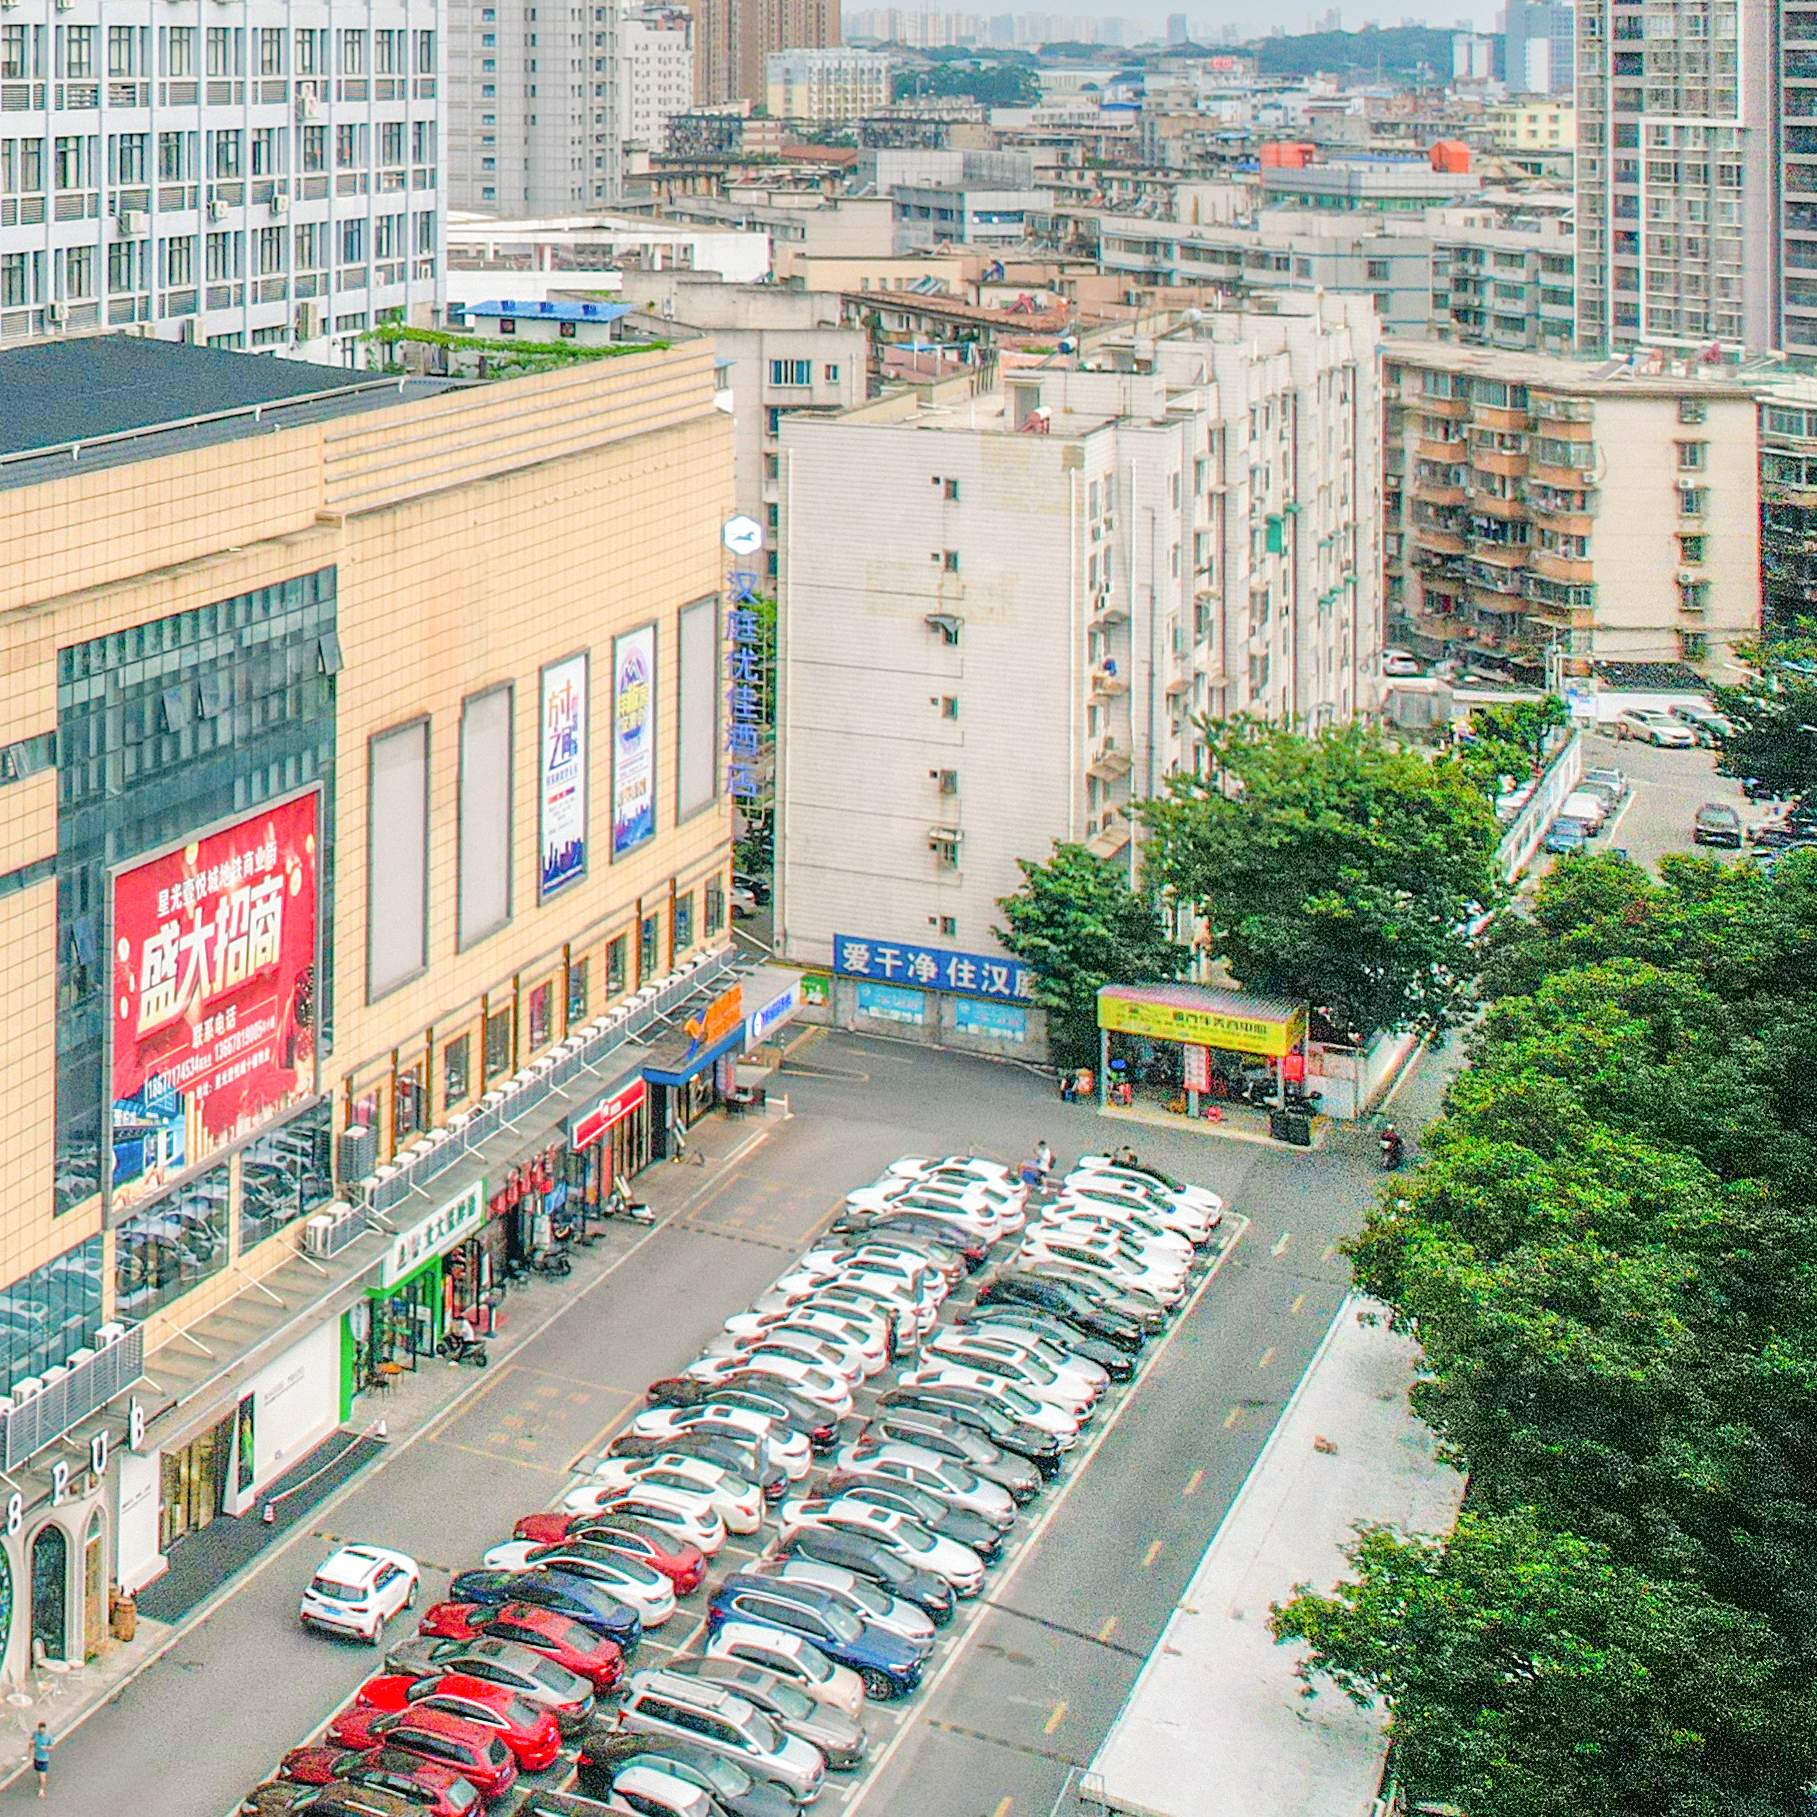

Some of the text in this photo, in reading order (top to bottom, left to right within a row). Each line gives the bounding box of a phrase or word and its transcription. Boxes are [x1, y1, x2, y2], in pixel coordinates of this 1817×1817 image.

[725, 571, 759, 797] 汉庭优佳酒店
[137, 874, 284, 1034] 盛大招商
[843, 942, 938, 982] 爱干净
[52, 1404, 145, 1506] PUB
